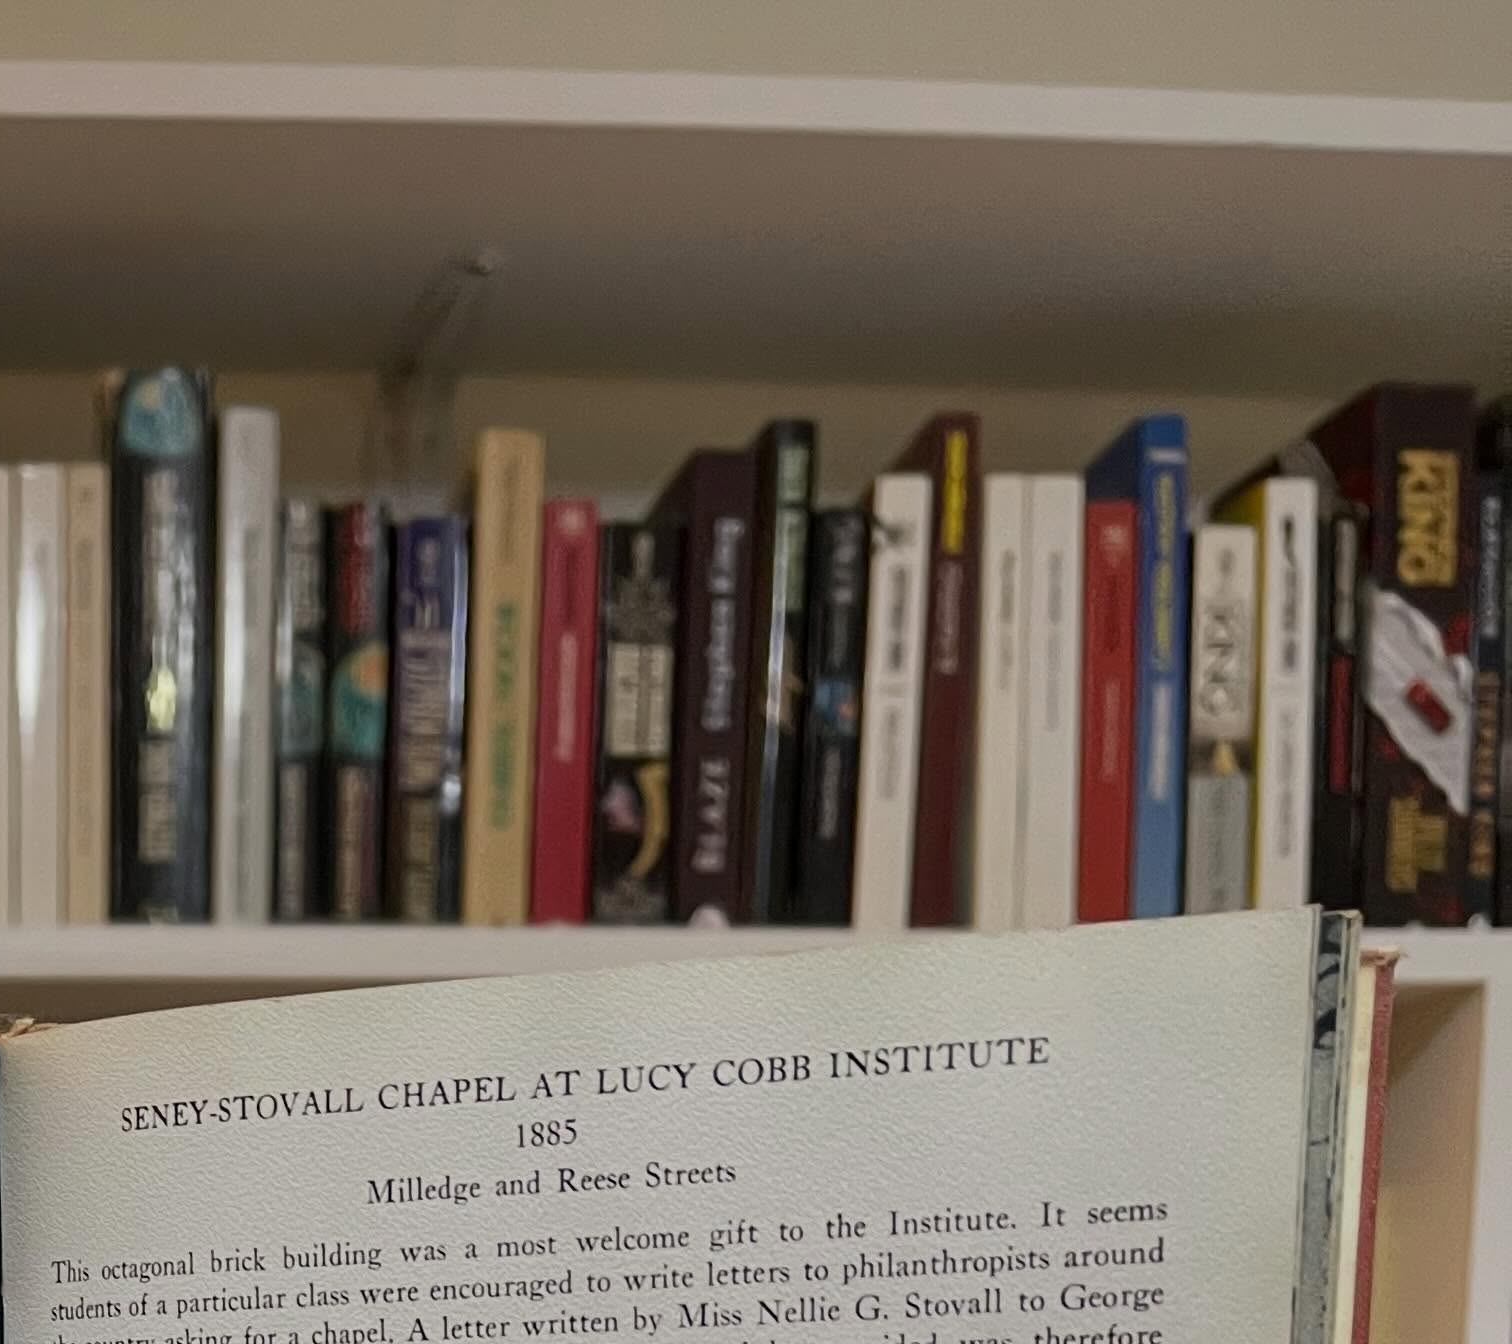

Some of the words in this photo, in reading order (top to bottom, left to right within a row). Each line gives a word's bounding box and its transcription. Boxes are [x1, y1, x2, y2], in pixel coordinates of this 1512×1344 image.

[1397, 450, 1443, 588] KING
[121, 1087, 365, 1133] SENEY-STOVALL
[377, 1076, 517, 1110] CHAPEL
[529, 1069, 581, 1100] AT
[596, 1062, 697, 1095] LUCY
[712, 1054, 811, 1087] COBB
[829, 1036, 1049, 1079] INSTITUTE
[517, 1118, 578, 1149] 1885
[367, 1174, 481, 1205] Milledge
[495, 1169, 541, 1197] and
[557, 1167, 631, 1193] Reese
[645, 1161, 737, 1189] Streets
[50, 1259, 90, 1284] This
[101, 1251, 195, 1284] octagonal
[210, 1247, 267, 1273] brick
[282, 1241, 382, 1271] building
[399, 1244, 447, 1263] was
[464, 1242, 479, 1260] a
[496, 1236, 557, 1258] most
[575, 1225, 690, 1253] welcome
[709, 1218, 759, 1253] gift
[779, 1223, 804, 1243] to
[825, 1212, 867, 1240] the
[889, 1207, 1017, 1236] Institute.
[1041, 1201, 1066, 1228] It
[1087, 1203, 1168, 1225] seems
[406, 1317, 430, 1343] A
[442, 1315, 511, 1341] letter
[521, 1309, 619, 1337] written
[632, 1305, 663, 1337] by
[677, 1301, 743, 1329] Miss
[757, 1295, 840, 1326] Nellie
[855, 1294, 889, 1321] G.
[905, 1287, 1002, 1319] Stovall
[1019, 1293, 1046, 1313] to
[1060, 1283, 1165, 1313] George
